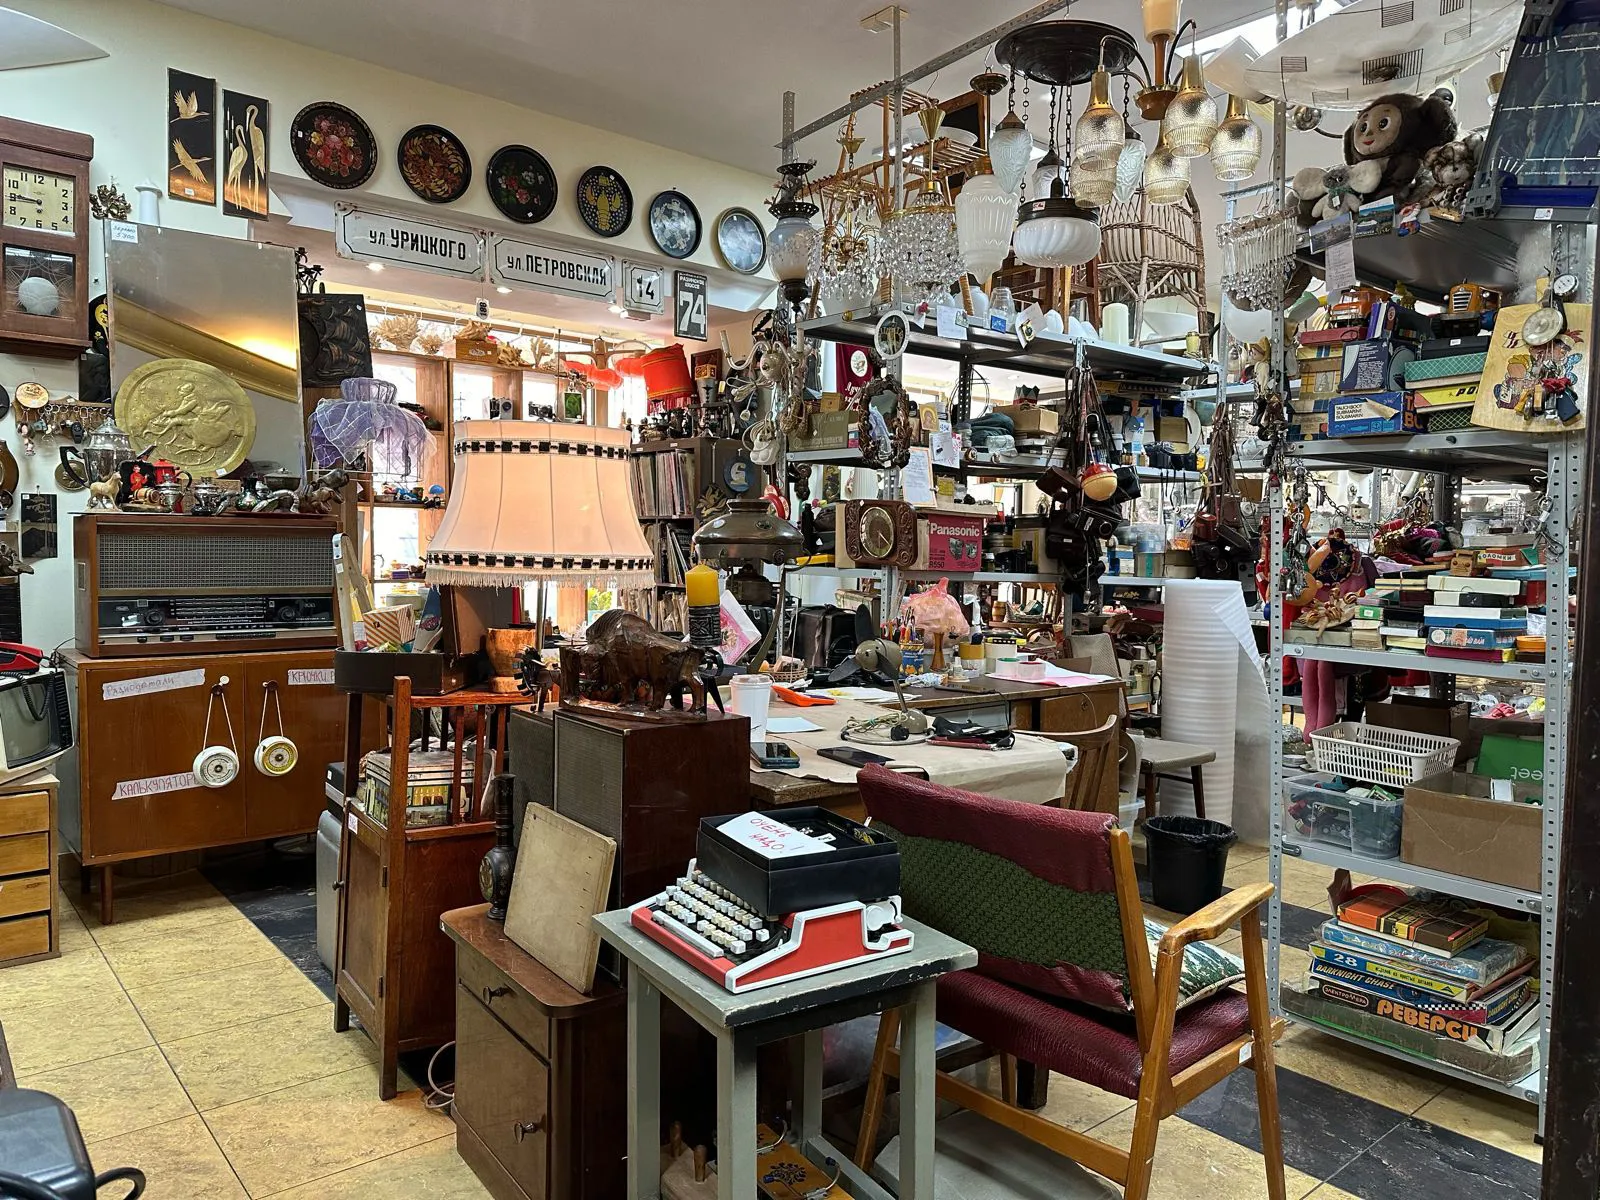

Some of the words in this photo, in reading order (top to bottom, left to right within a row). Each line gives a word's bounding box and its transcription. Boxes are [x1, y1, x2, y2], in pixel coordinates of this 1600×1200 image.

[20, 172, 28, 182] 11
[33, 174, 45, 185] 12
[8, 179, 19, 189] 10
[54, 178, 58, 187] 1
[9, 192, 17, 201] 9
[61, 189, 69, 198] 2
[9, 205, 17, 215] 8
[61, 202, 69, 211] 3
[19, 217, 27, 226] 7
[35, 219, 43, 228] 6
[61, 215, 69, 225] 4
[51, 222, 58, 231] 5
[369, 230, 389, 247] ул.
[390, 228, 466, 260] УРИЦКОГО
[507, 255, 525, 272] ул.
[525, 254, 607, 286] ПЕТРОВСКАЯ
[636, 273, 655, 300] 14
[679, 290, 706, 335] 74
[930, 522, 980, 537] Panasonic
[750, 818, 792, 838] ОЧЕНЬ
[1333, 953, 1358, 967] 28
[1315, 963, 1364, 981] DARKNIGHT
[1364, 975, 1396, 990] CHASE
[1376, 999, 1478, 1042] РЕВЕРСИ
